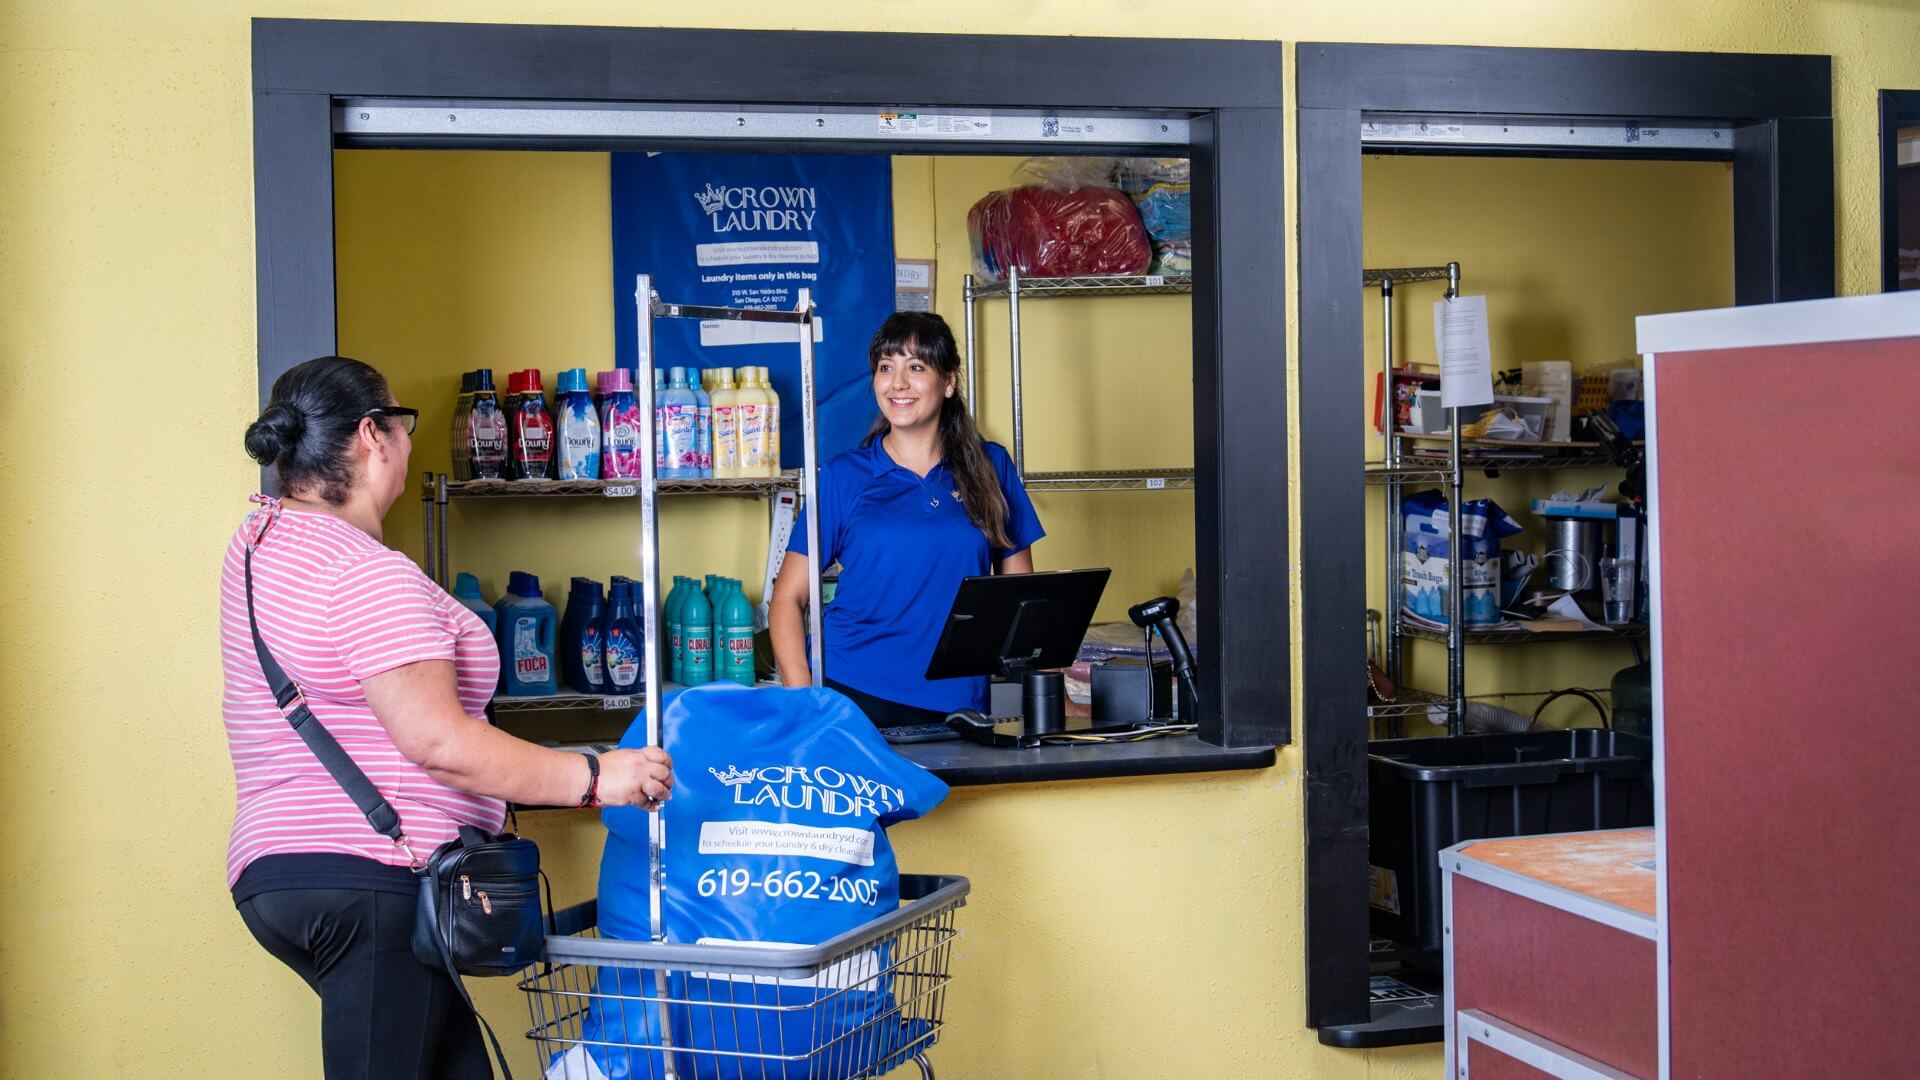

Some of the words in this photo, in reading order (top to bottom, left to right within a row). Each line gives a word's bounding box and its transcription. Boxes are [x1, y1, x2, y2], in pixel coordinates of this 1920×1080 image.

[724, 187, 816, 209] CROWN
[713, 210, 816, 232] LAUNDRY
[701, 274, 734, 282] Laundry
[735, 272, 757, 281] items
[758, 272, 776, 281] only
[777, 272, 785, 280] in
[786, 271, 801, 280] this
[801, 271, 817, 281] bag
[896, 268, 922, 280] NDRY
[471, 438, 503, 450] Downy
[519, 438, 550, 450] Downy
[564, 436, 594, 449] Downy
[1149, 479, 1163, 487] 102
[607, 486, 632, 495] $4.00
[1411, 568, 1427, 581] Trash
[1428, 571, 1444, 584] Bags
[517, 656, 547, 673] FOCA
[605, 699, 630, 709] $4.00
[757, 766, 905, 807] CROWN
[729, 827, 748, 836] Visit
[713, 839, 752, 848] schedule
[754, 841, 773, 850] your
[775, 839, 808, 851] laundry
[818, 842, 833, 854] dry
[697, 869, 880, 906] 619-662-2005
